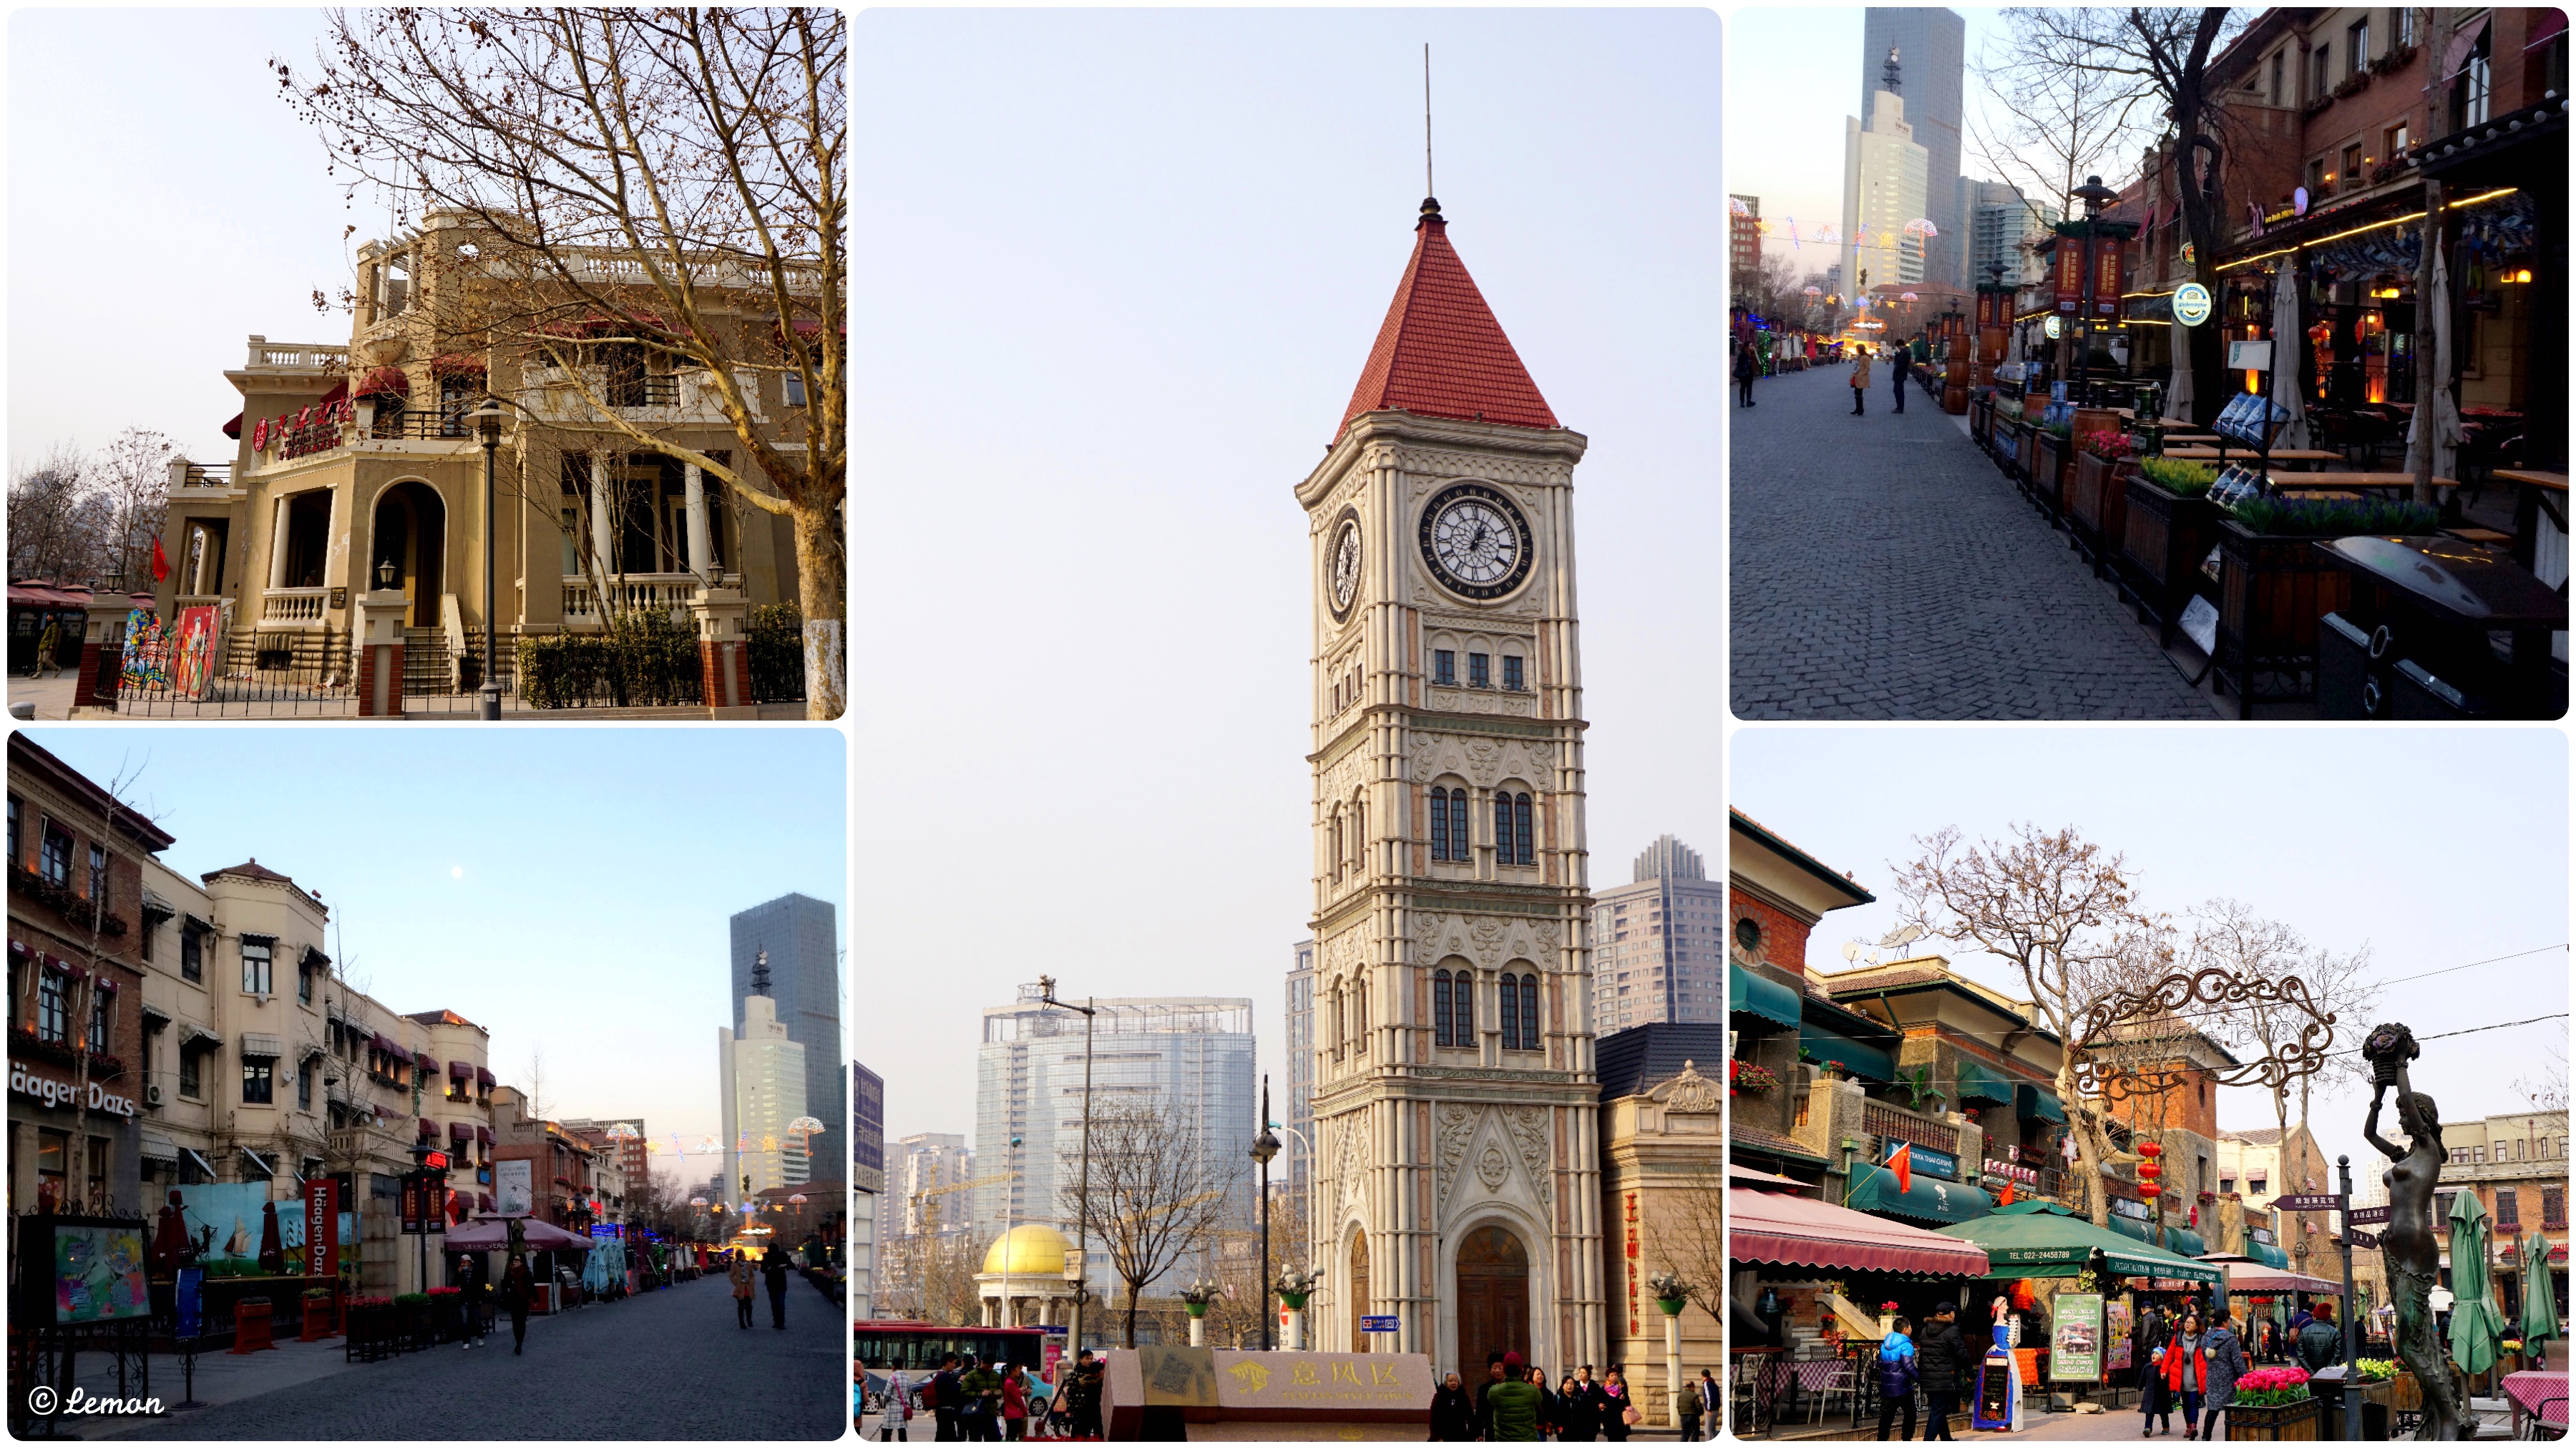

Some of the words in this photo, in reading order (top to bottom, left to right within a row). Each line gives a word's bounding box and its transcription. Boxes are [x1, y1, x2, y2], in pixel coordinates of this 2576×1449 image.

[7, 1058, 82, 1108] äagen
[89, 1081, 134, 1117] Dazs
[1924, 1155, 1936, 1163] THAI
[1936, 1158, 1952, 1168] CUISINE
[1290, 1359, 1402, 1387] 意风区
[1282, 1391, 1332, 1401] ITALIAN
[1335, 1391, 1374, 1401] STYLE
[1376, 1391, 1414, 1402] TOWN
